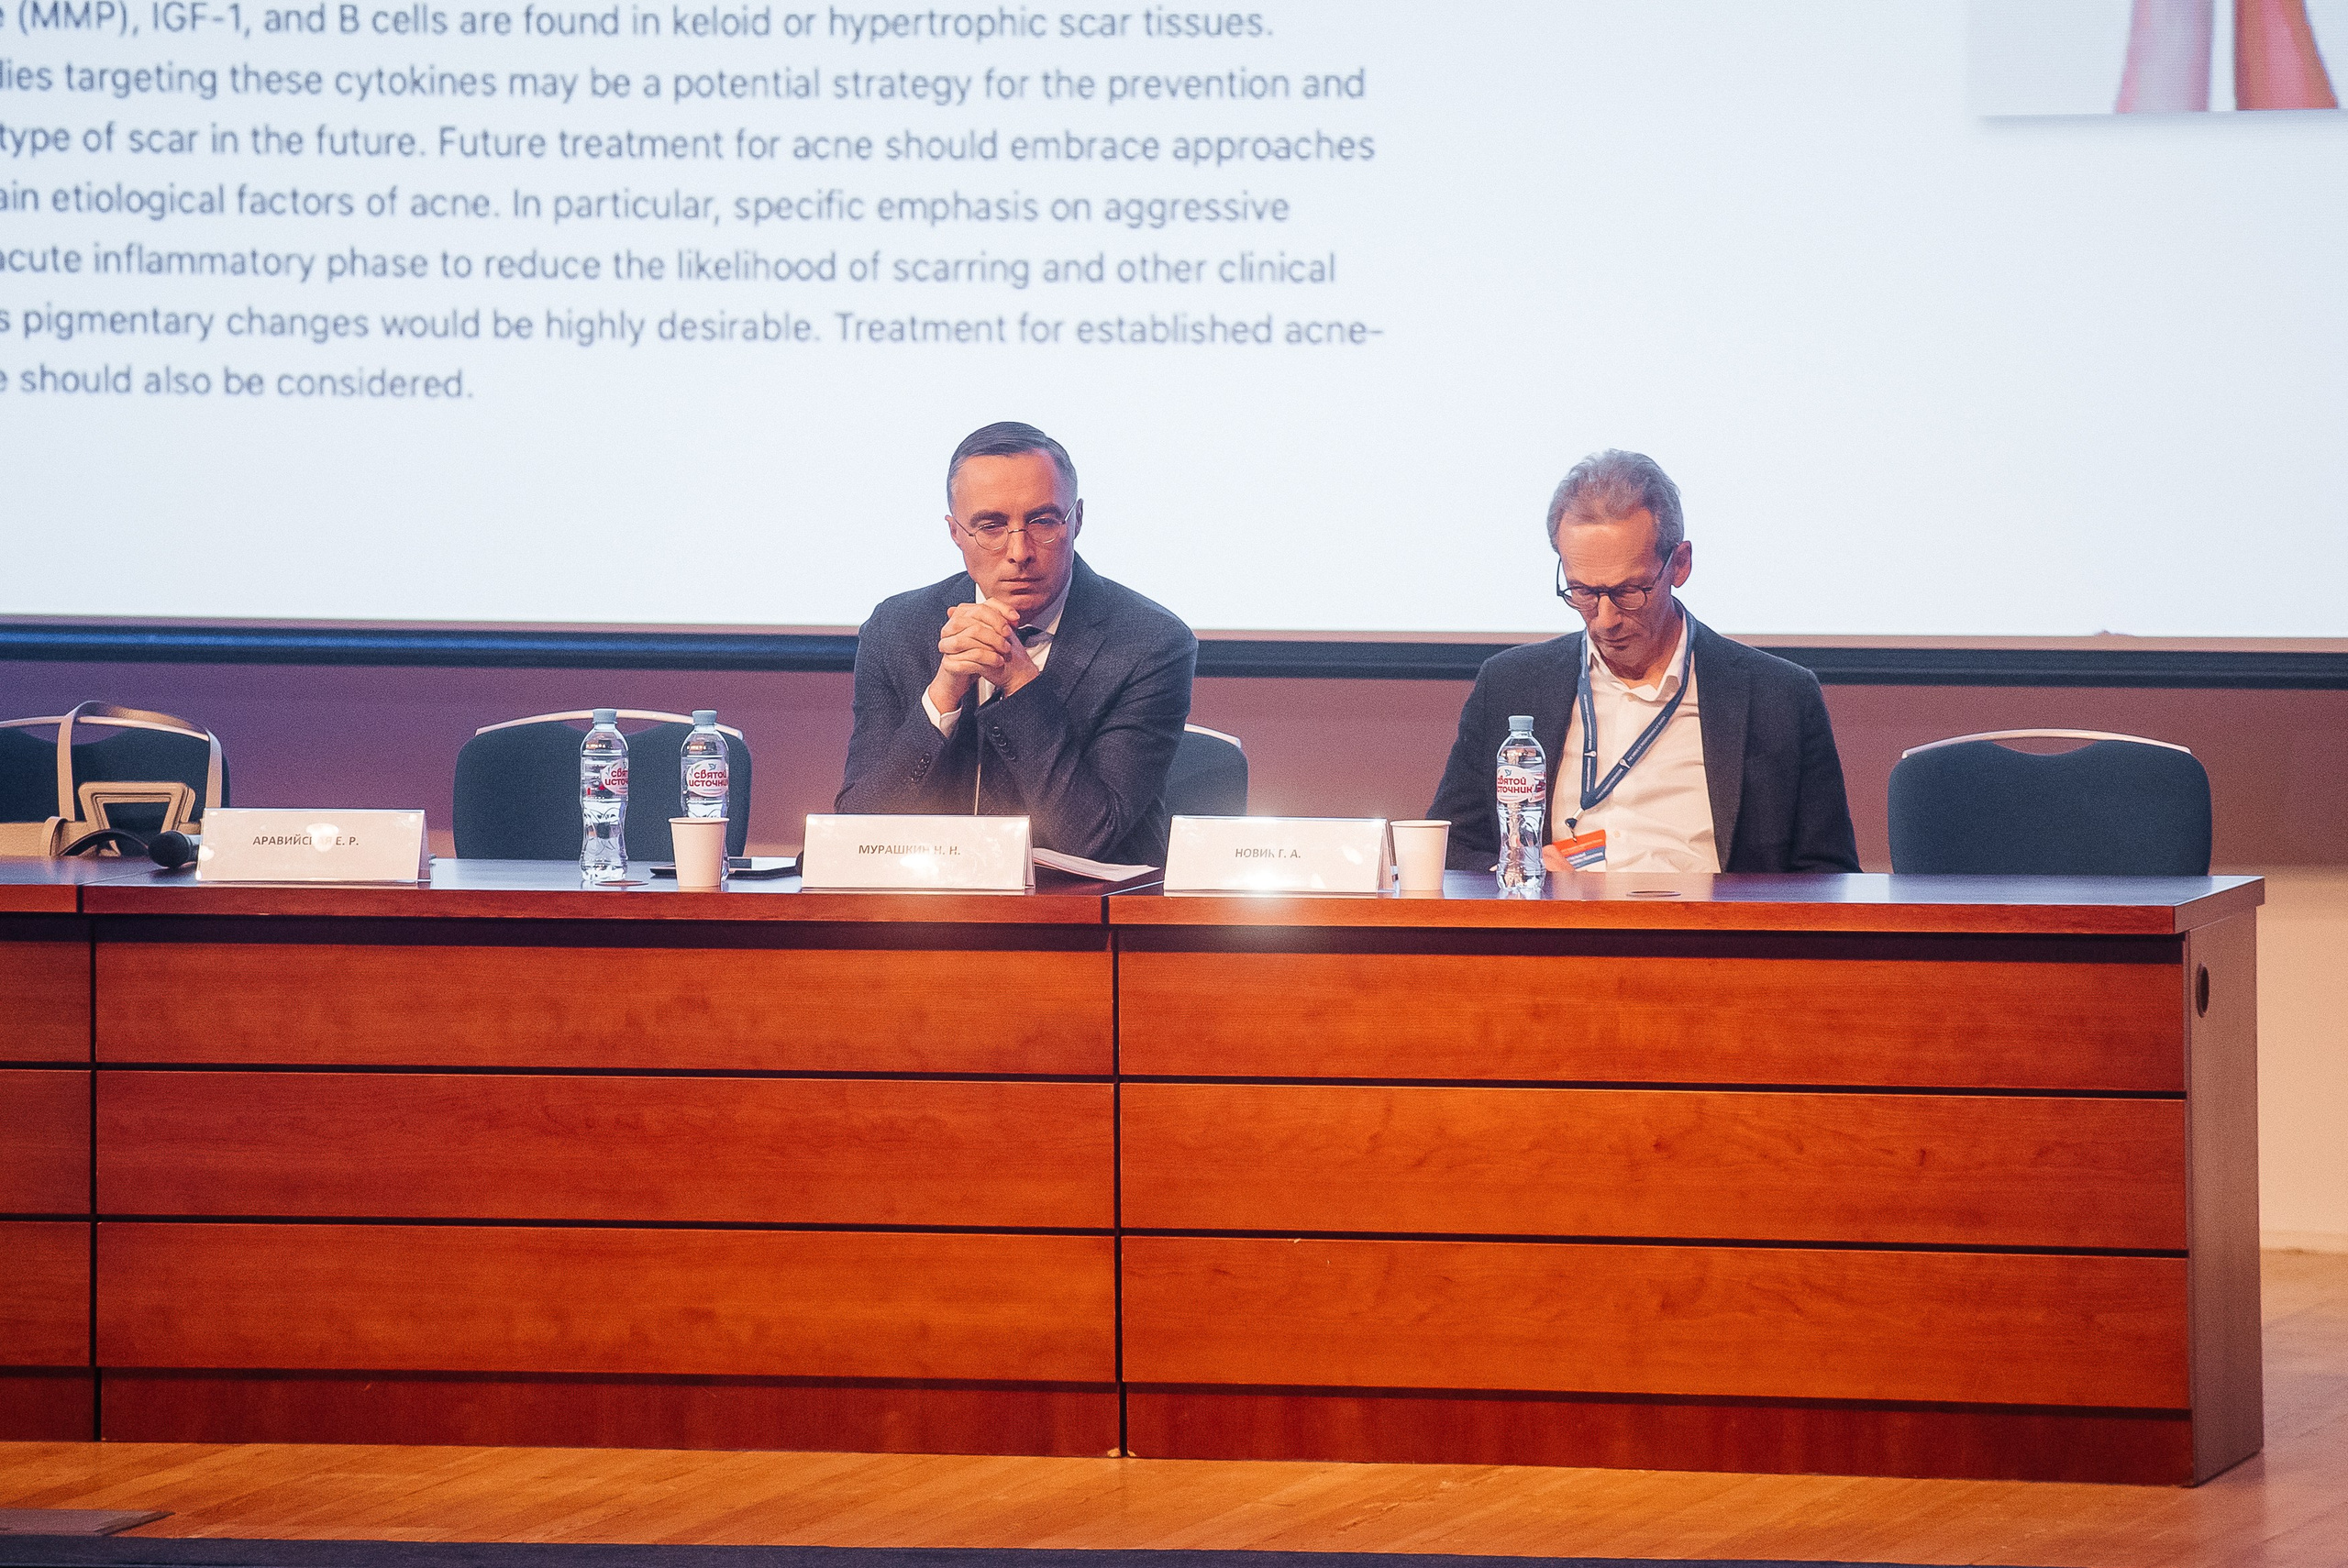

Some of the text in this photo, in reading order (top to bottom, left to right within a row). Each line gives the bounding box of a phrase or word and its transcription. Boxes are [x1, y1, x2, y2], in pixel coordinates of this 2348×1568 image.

[18, 0, 138, 37] (MMP),
[153, 0, 250, 39] IGF-1,
[264, 0, 326, 34] and
[339, 4, 360, 34] B
[371, 4, 448, 35] cells
[460, 12, 512, 36] are
[524, 4, 619, 37] found
[633, 6, 659, 35] in
[673, 6, 770, 37] keloid
[783, 14, 815, 37] or
[829, 6, 1046, 44] hypertrophic
[1059, 14, 1131, 38] scar
[1144, 6, 1272, 38] tissues.
[0, 59, 1365, 105] ies targeting these cytokines may be a potential strategy for the prevention and
[0, 121, 1375, 166] type of scar in the future. Future treatment for acne should embrace approaches
[51, 182, 225, 221] etiological
[237, 183, 354, 216] factors
[366, 185, 397, 216] of
[411, 194, 499, 217] acne.
[514, 189, 541, 217] In
[554, 188, 719, 226] particular,
[735, 189, 863, 226] specific
[877, 191, 1038, 226] emphasis
[1050, 198, 1091, 222] on
[1104, 191, 1290, 229] aggressive
[94, 242, 315, 283] inflammatory
[327, 247, 428, 282] phase
[441, 251, 472, 279] to
[485, 249, 601, 280] reduce
[614, 249, 665, 280] the
[678, 249, 836, 282] likelihood
[849, 250, 880, 282] of
[893, 251, 1029, 290] scarring
[1043, 252, 1104, 282] and
[1117, 253, 1206, 283] other
[1219, 252, 1335, 283] clinical
[23, 303, 214, 342] pigmentary
[227, 306, 369, 344] changes
[382, 309, 480, 338] would
[493, 309, 533, 339] be
[547, 309, 645, 347] highly
[658, 311, 819, 342] desirable.
[836, 312, 1005, 343] Treatment
[1019, 313, 1063, 343] for
[1077, 315, 1272, 344] established
[20, 363, 131, 394] should
[144, 366, 212, 395] also
[224, 366, 264, 396] be
[277, 369, 471, 398] considered.
[336, 835, 346, 845] Е.
[349, 835, 360, 845] Р.
[858, 845, 930, 856] МУРАШКИН
[949, 845, 961, 856] Н.
[1278, 848, 1287, 858] Г.
[1290, 849, 1301, 858] А.
